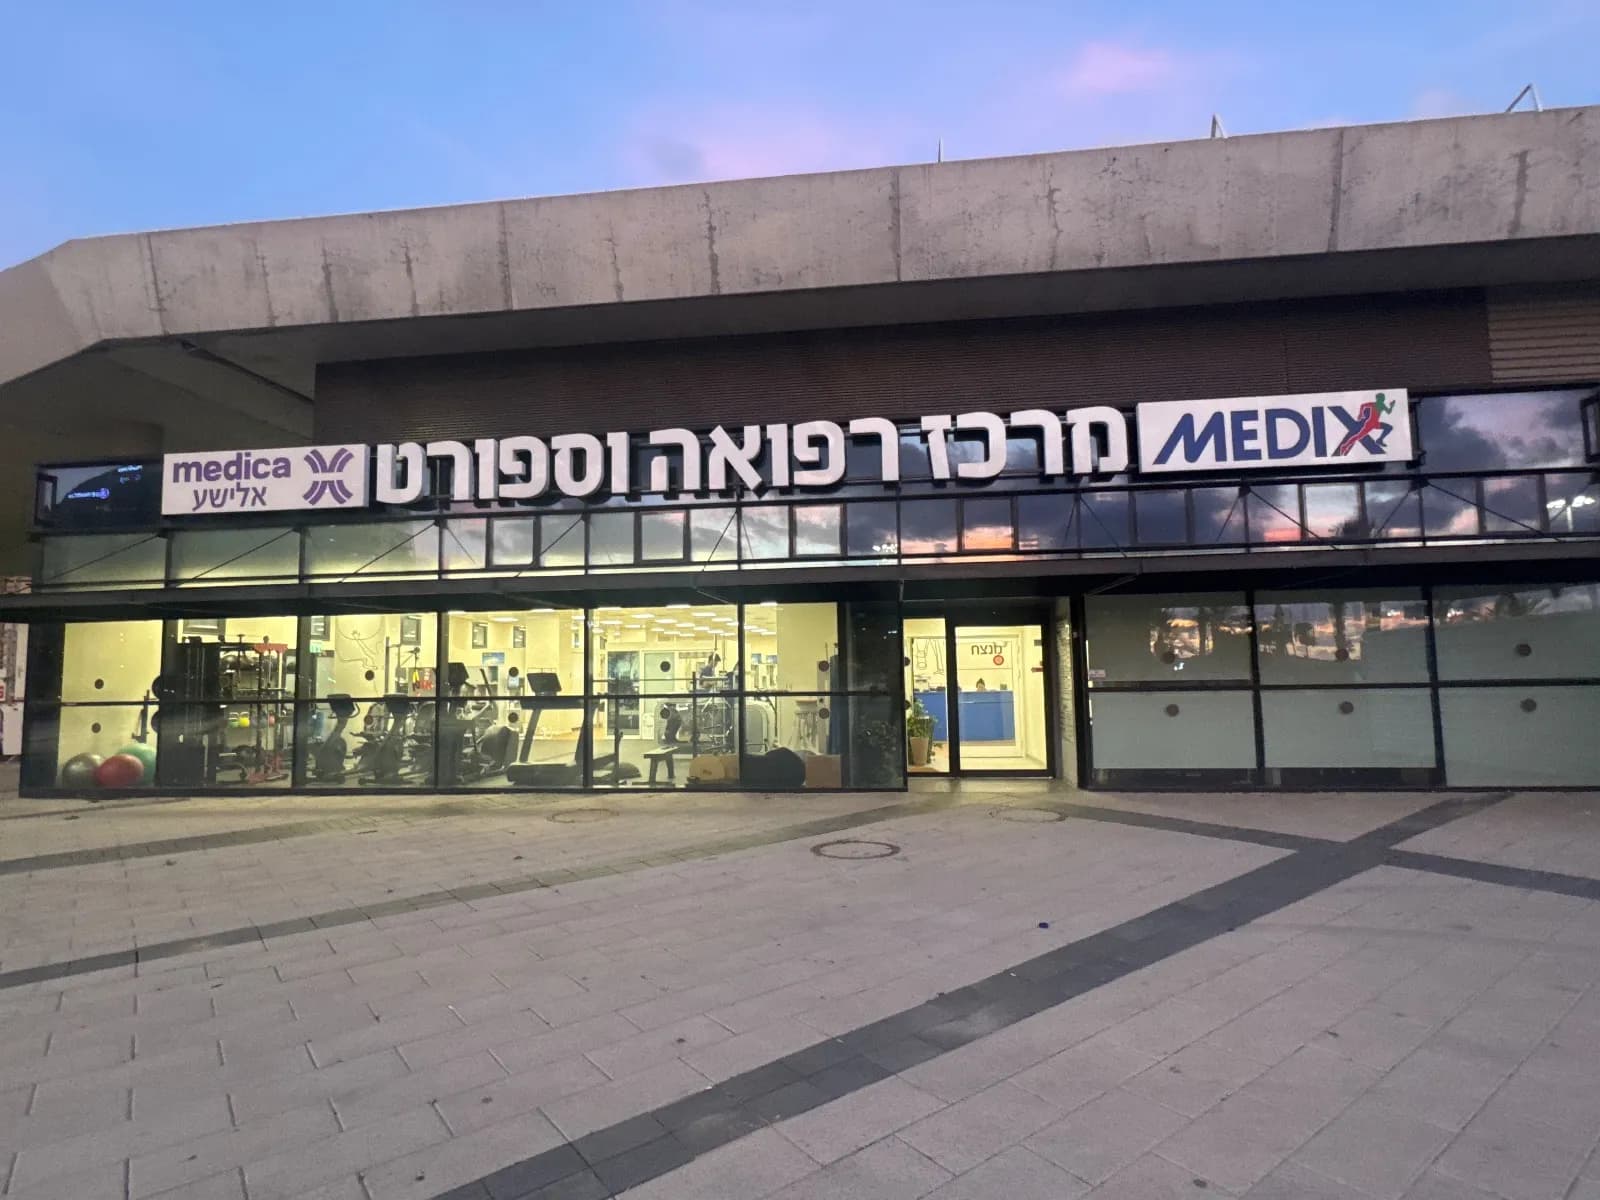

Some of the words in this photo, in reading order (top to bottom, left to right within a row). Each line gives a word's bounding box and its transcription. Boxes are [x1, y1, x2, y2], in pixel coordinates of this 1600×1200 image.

[172, 452, 292, 483] medica
[376, 431, 631, 505] וספורט
[649, 416, 900, 491] רפואה
[921, 405, 1129, 480] מרכז
[1152, 405, 1387, 466] MEDIX
[191, 482, 268, 512] אלישע
